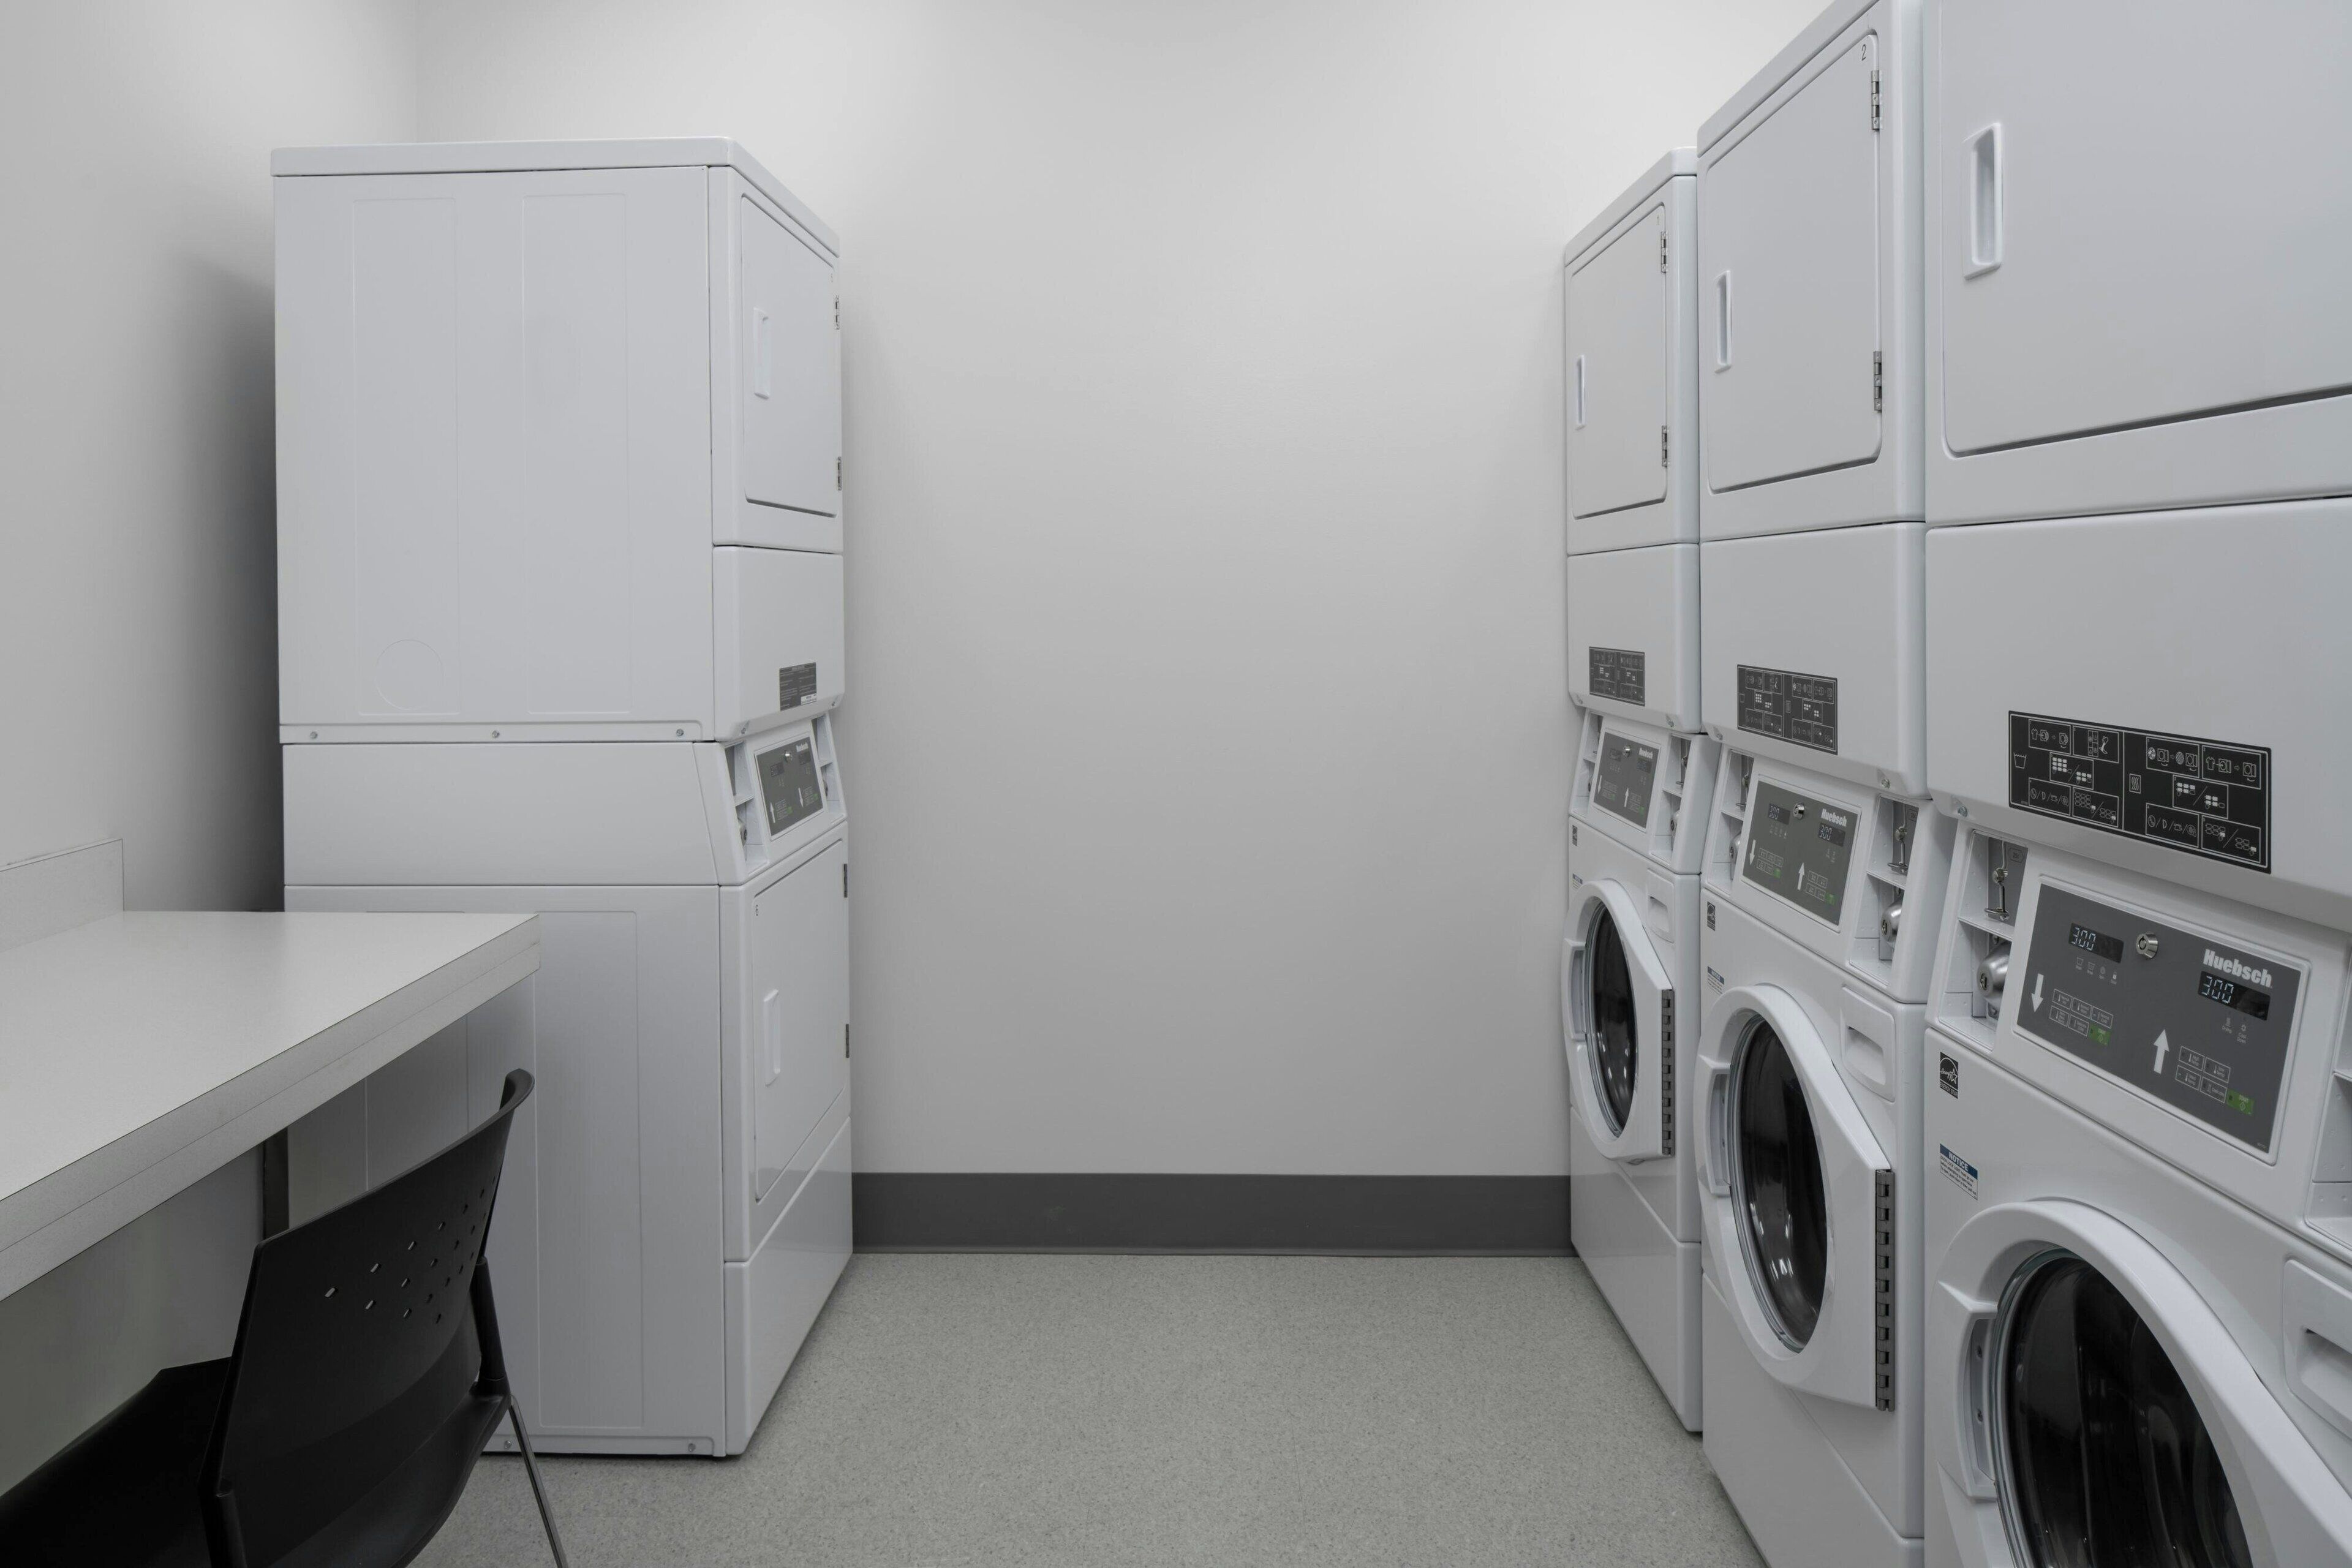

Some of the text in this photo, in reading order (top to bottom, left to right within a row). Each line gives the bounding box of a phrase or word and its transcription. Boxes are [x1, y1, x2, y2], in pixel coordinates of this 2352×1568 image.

[1861, 43, 1866, 61] 2
[1821, 809, 1847, 827] Huebsch
[755, 904, 759, 916] 6
[2071, 927, 2097, 951] 300
[2203, 949, 2272, 988] Huebsch
[2201, 975, 2234, 1005] 300
[1949, 1151, 1968, 1172] NOTICE
